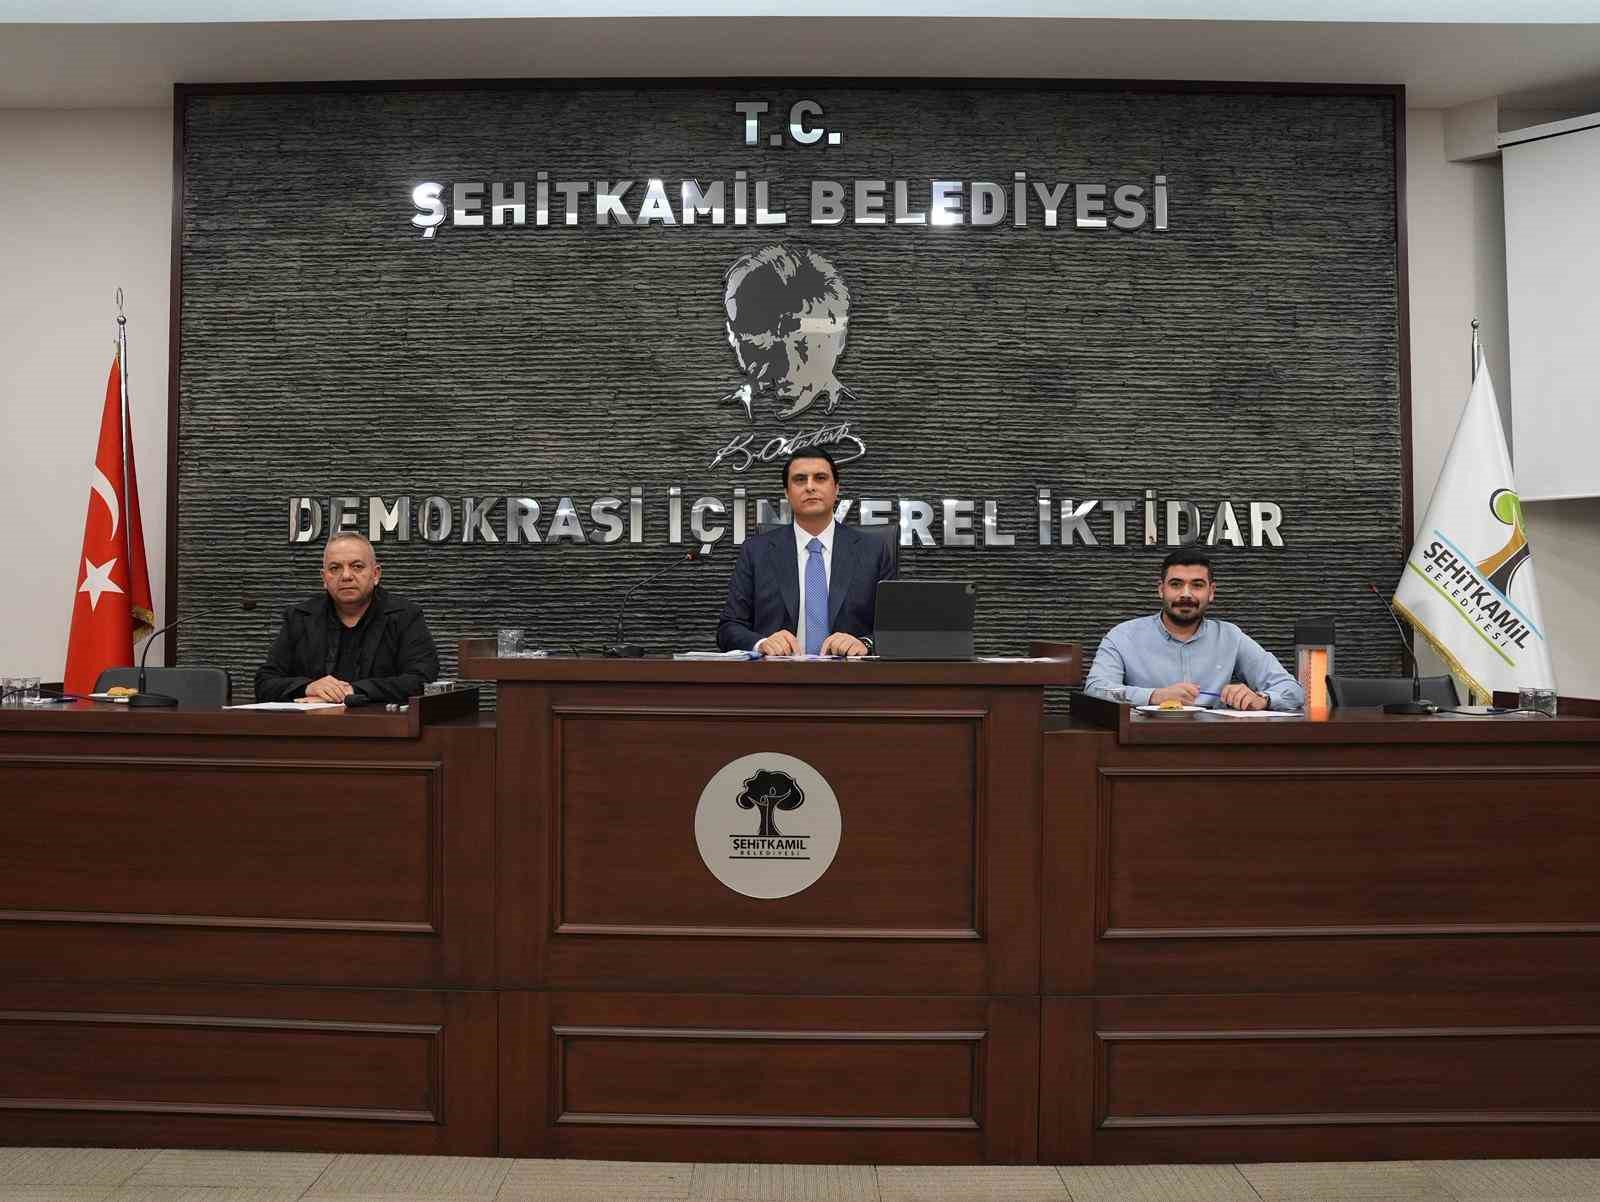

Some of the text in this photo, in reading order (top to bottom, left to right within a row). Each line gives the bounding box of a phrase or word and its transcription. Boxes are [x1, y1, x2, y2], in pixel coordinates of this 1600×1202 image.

[735, 101, 842, 146] T.C.
[411, 171, 1168, 238] ŞEHİTKAMİL BELEDİYESİ
[289, 487, 643, 543] DEMOKRASİ
[1038, 488, 1285, 547] İKTİDAR
